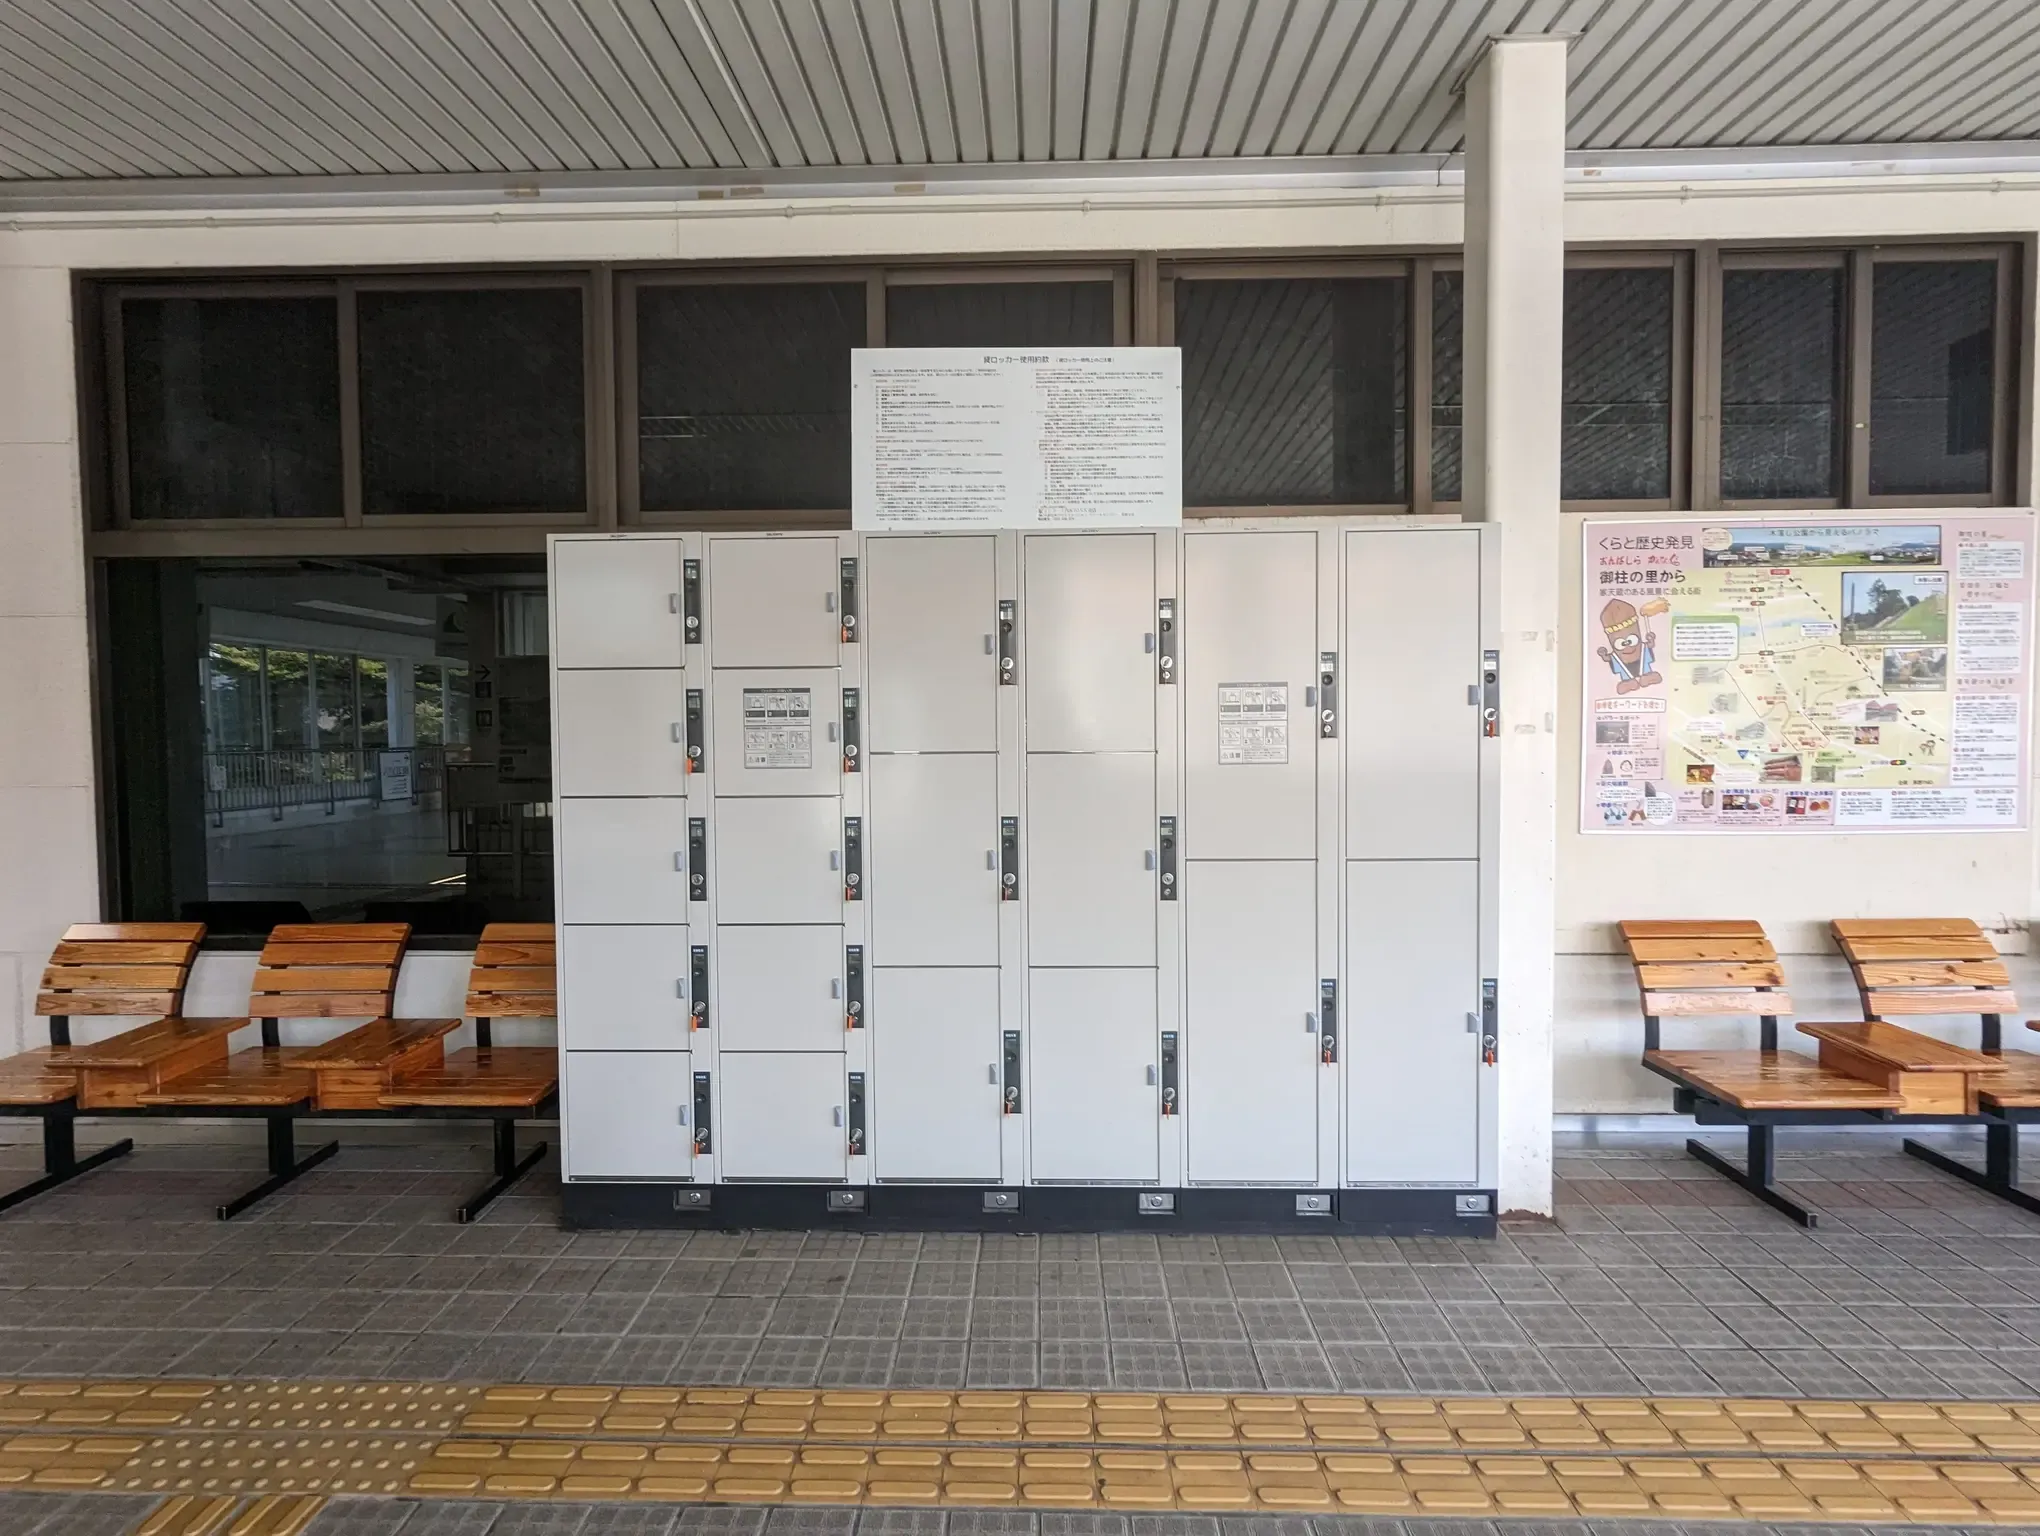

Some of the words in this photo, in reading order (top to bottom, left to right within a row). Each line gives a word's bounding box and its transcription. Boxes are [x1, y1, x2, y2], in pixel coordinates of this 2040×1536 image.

[983, 355, 1050, 364] 貸ロッカー使用約款
[1598, 535, 1695, 550] くらと歴史発見
[1599, 555, 1642, 566] おんばしら
[1599, 569, 1686, 585] 御柱の里から
